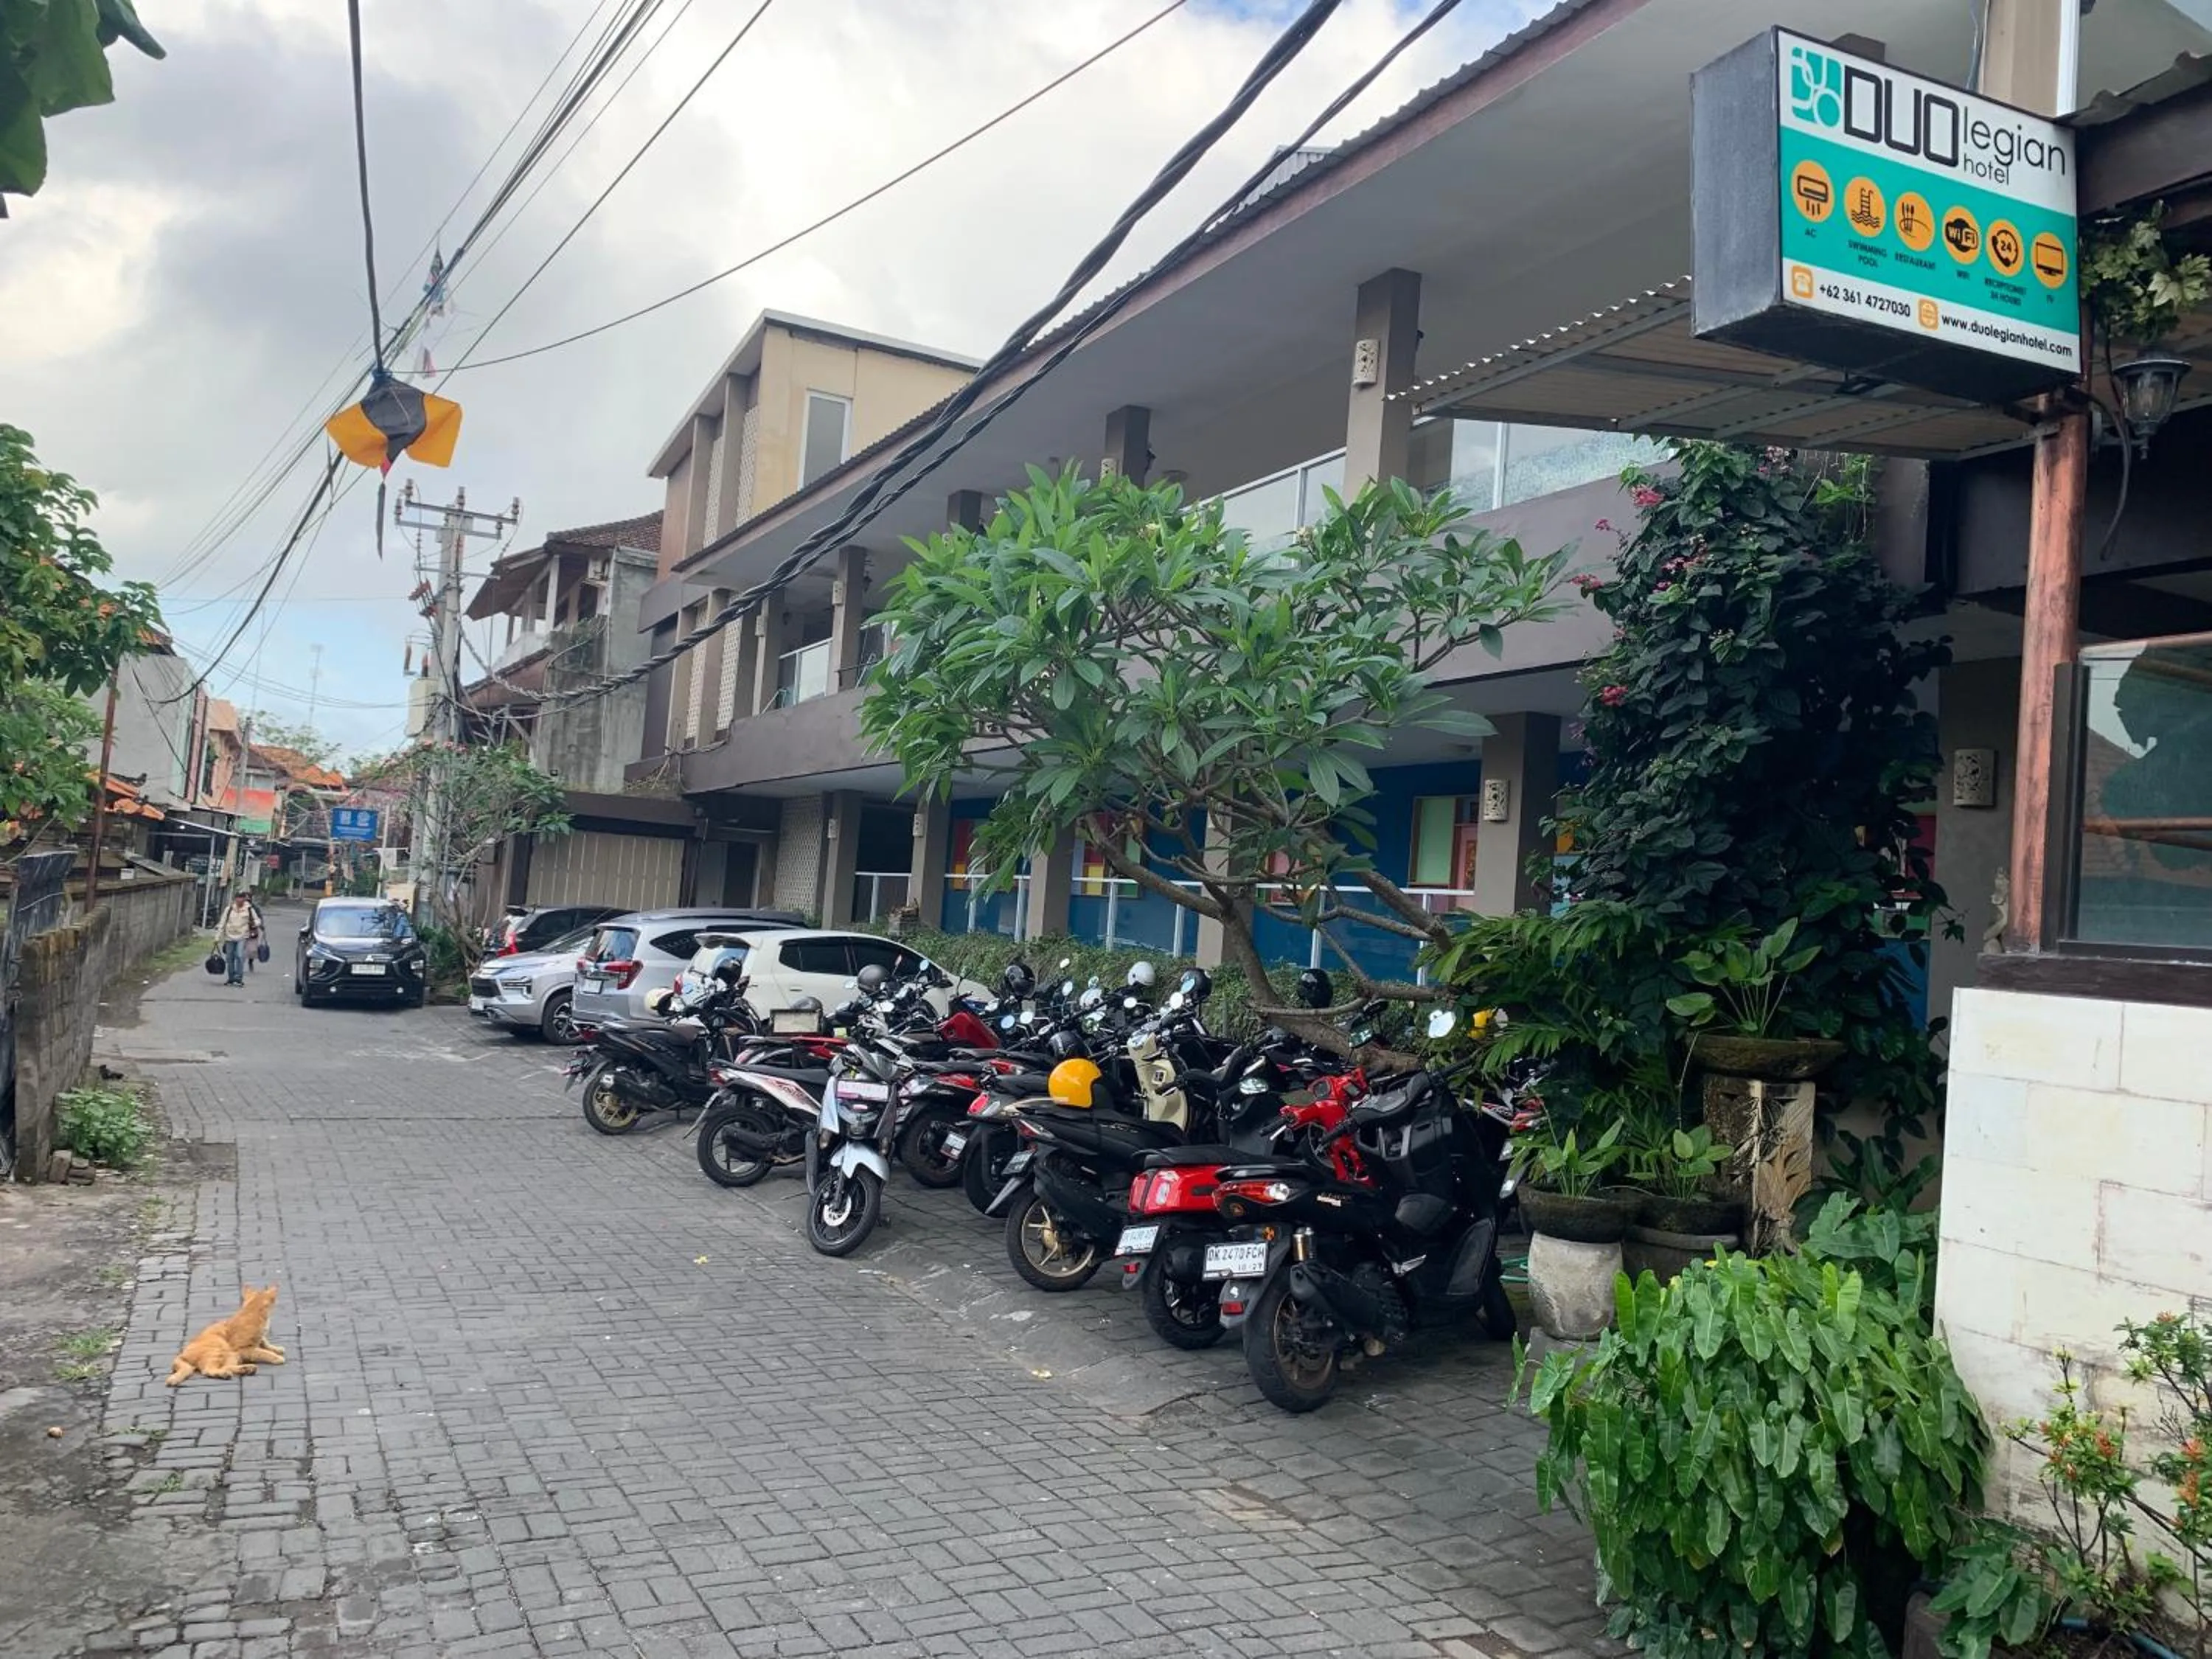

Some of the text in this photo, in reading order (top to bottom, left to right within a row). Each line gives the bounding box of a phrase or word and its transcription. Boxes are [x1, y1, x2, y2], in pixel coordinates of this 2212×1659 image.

[1844, 65, 2065, 176] DUO legian
[1964, 153, 2009, 186] hotel
[1804, 227, 1817, 238] AC
[1848, 239, 1888, 258] SWIMMING
[2000, 240, 2013, 253] 24
[1858, 254, 1879, 268] POOL
[1895, 251, 1935, 271] RESTAURANT
[1820, 284, 1911, 317] +62 361 4727030
[1941, 313, 2073, 357] www.duolegianhotel.com
